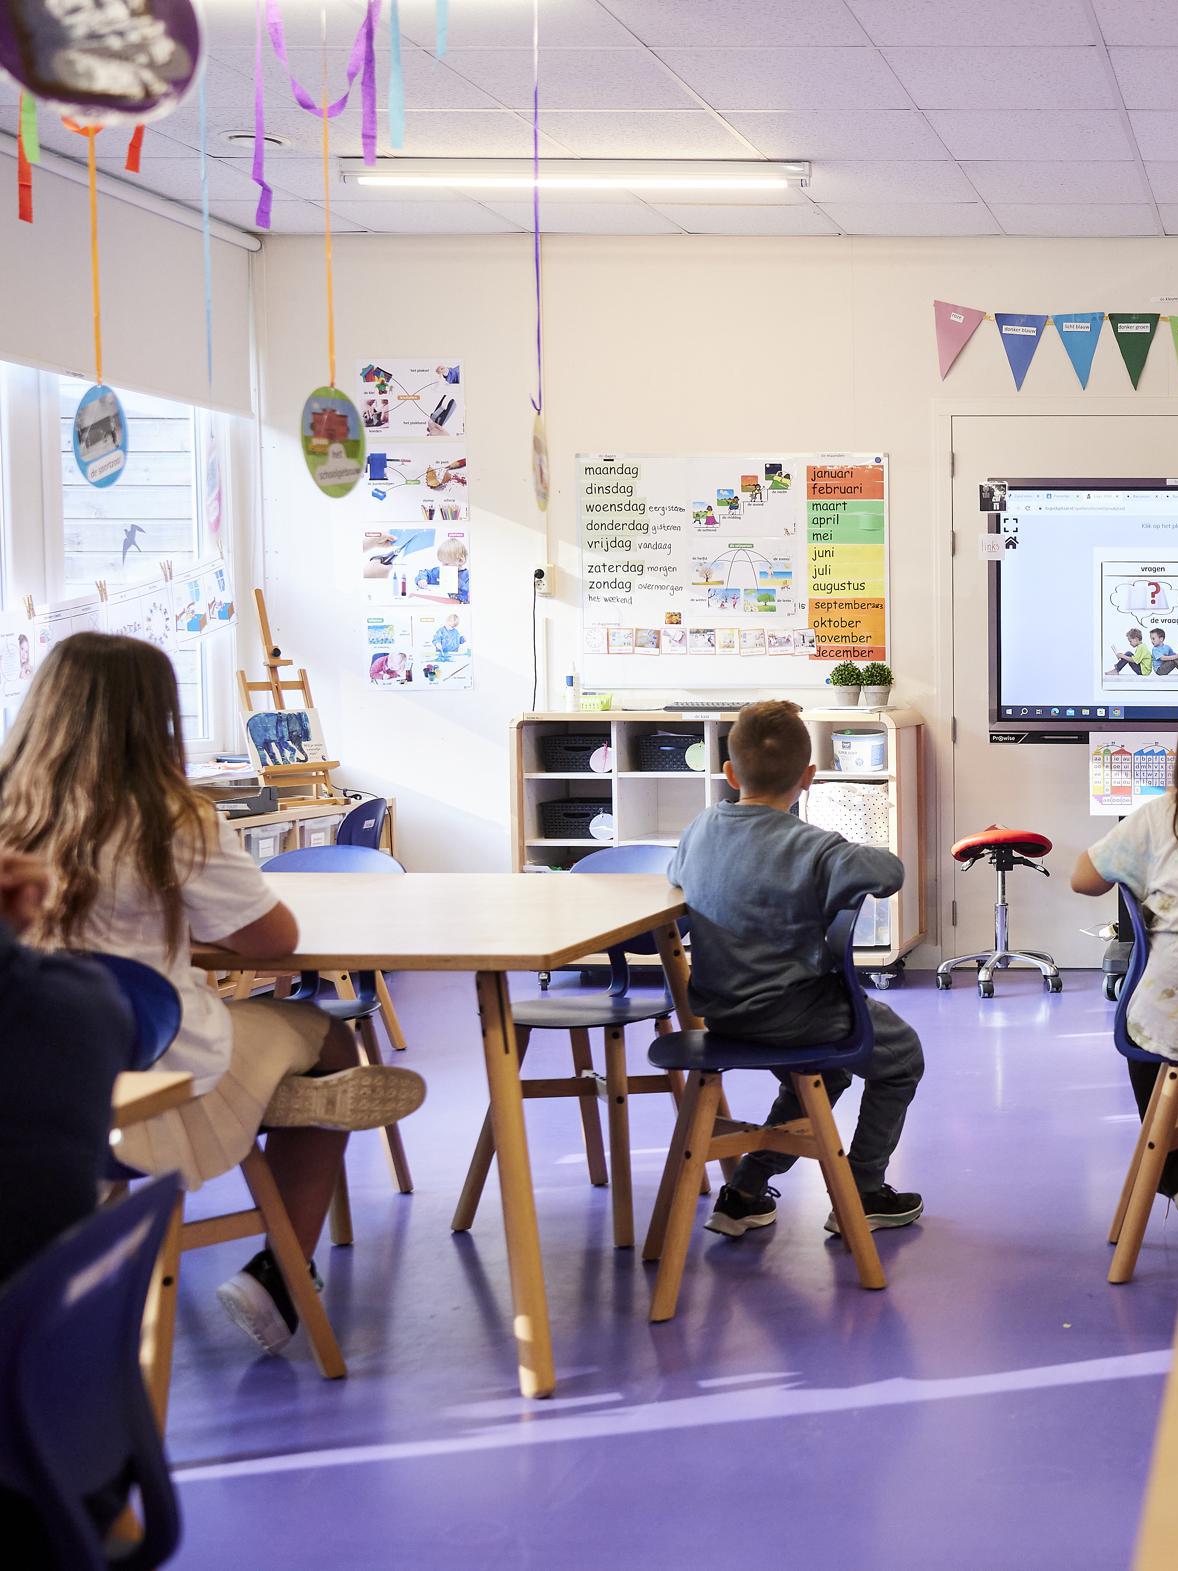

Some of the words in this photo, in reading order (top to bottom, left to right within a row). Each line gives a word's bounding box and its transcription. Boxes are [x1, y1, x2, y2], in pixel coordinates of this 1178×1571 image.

[584, 464, 639, 478] maandag
[811, 468, 854, 481] januari
[586, 482, 633, 497] dinsdag
[812, 483, 862, 495] februari
[586, 500, 646, 515] woensdag
[649, 505, 685, 516] eergisteren
[812, 501, 847, 511] maart
[586, 520, 649, 534] donderdag
[812, 514, 839, 528] april
[652, 524, 681, 534] gisteren
[812, 530, 832, 540] mei
[587, 537, 632, 552] vrijdag
[638, 542, 672, 555] vandaag
[812, 546, 834, 561] juni
[588, 561, 644, 576] zaterdag
[647, 566, 677, 576] morgen
[812, 565, 831, 579] juli
[589, 578, 632, 592] zondag
[638, 583, 683, 596] overmorgen
[813, 581, 865, 594] augustus
[588, 594, 600, 602] het
[603, 596, 632, 604] weekend
[815, 600, 872, 612] september
[813, 617, 861, 628] oktober
[816, 632, 872, 643] november
[814, 647, 873, 657] december
